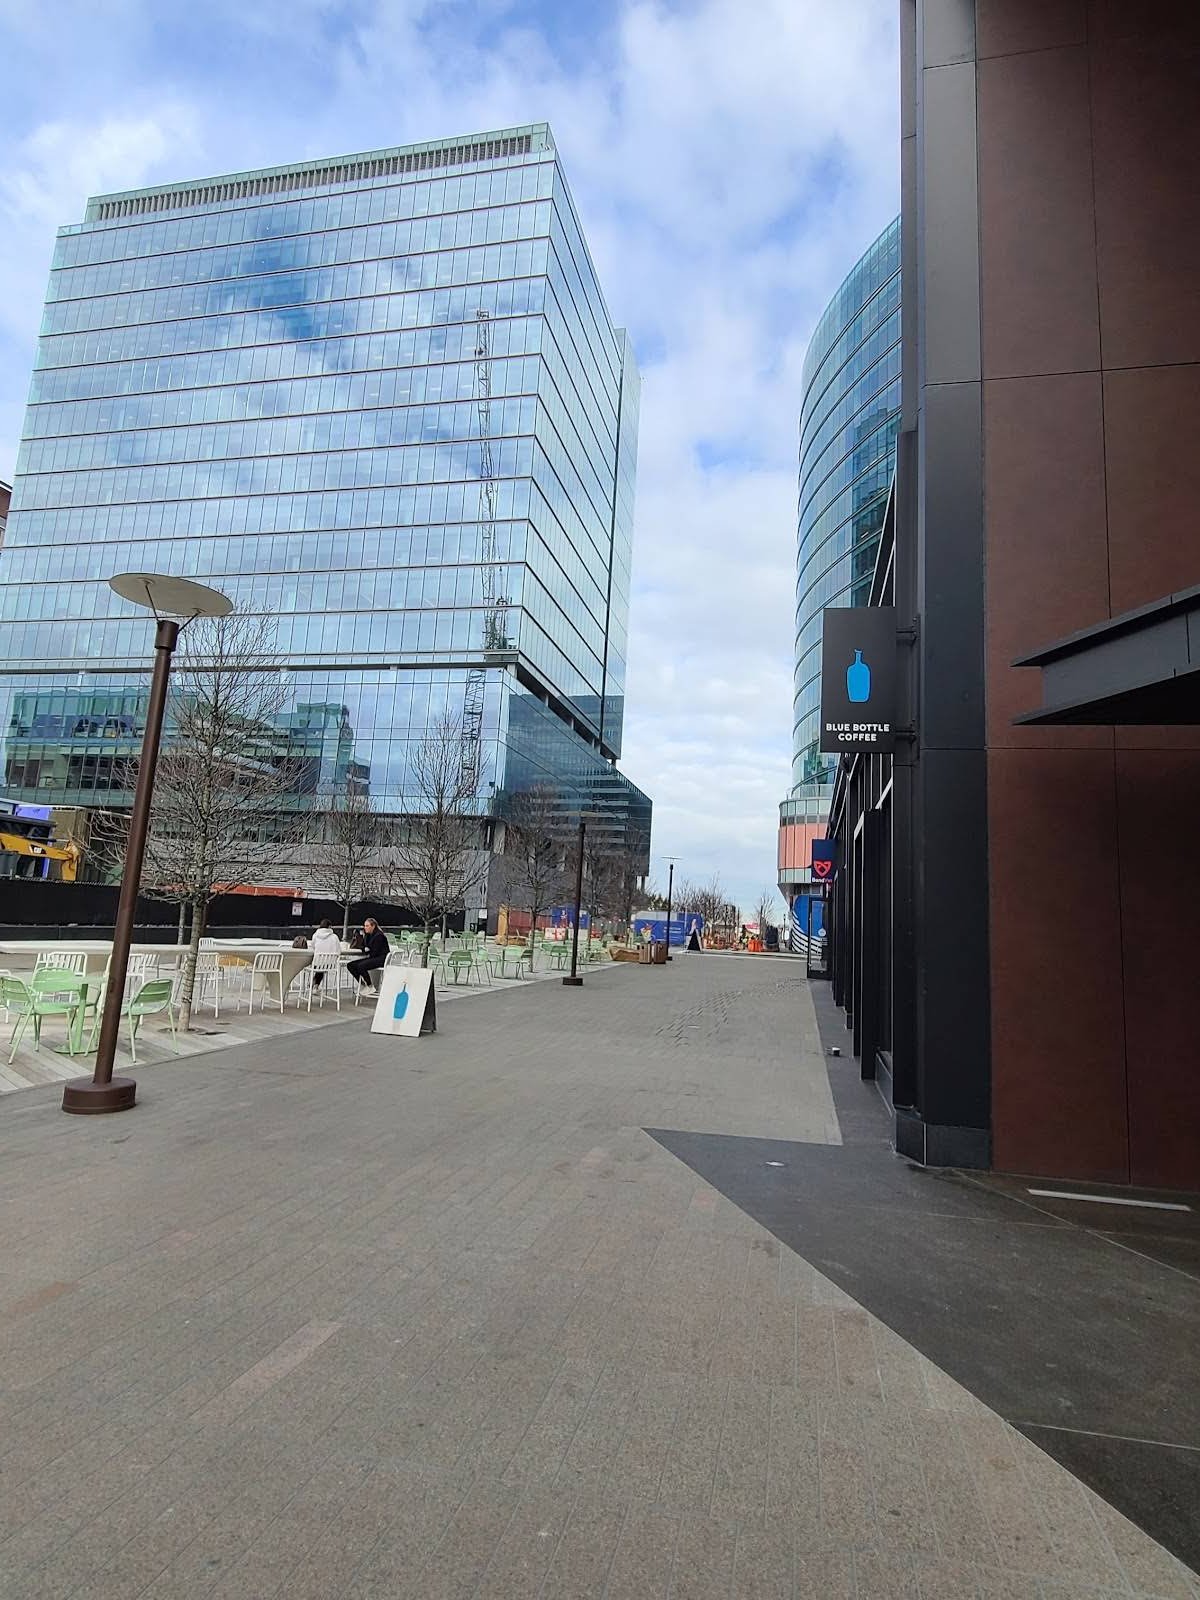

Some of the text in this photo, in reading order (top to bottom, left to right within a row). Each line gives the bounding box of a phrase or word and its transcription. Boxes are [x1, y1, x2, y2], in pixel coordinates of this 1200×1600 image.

[826, 723, 890, 732] BLUE BOTTLE
[838, 733, 877, 742] COFFEE
